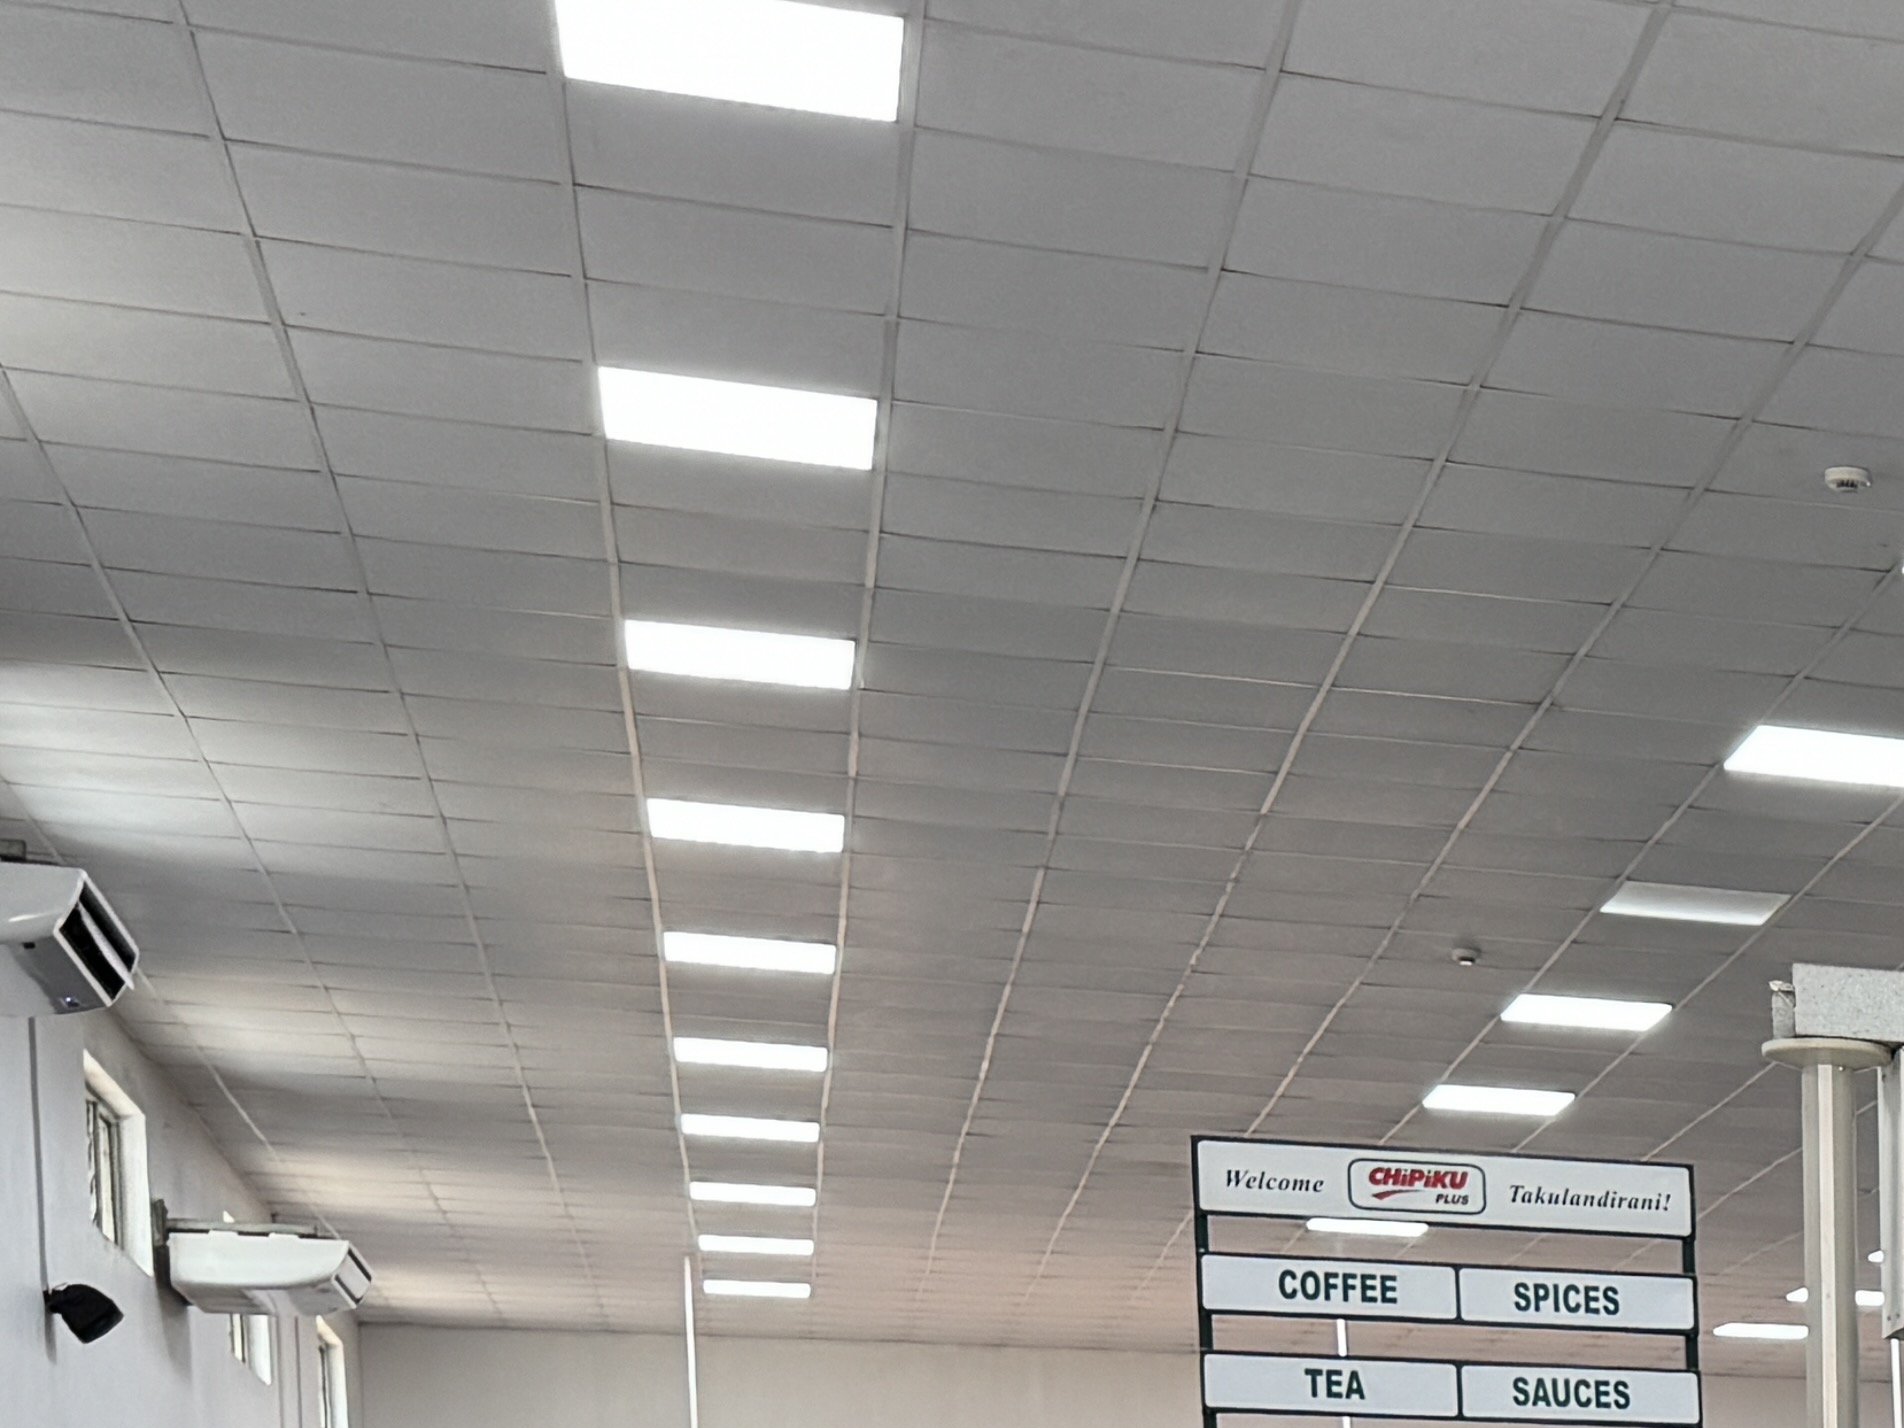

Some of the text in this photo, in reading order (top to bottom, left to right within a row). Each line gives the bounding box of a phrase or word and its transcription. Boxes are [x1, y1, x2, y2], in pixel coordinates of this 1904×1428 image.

[1225, 1168, 1325, 1194] Welcome
[1509, 1184, 1671, 1212] Takulandirani!
[1435, 1193, 1470, 1206] PLUS
[1279, 1268, 1398, 1305] COFFEE
[1513, 1282, 1620, 1316] SPICES
[1304, 1367, 1366, 1401] TEA
[1512, 1376, 1630, 1411] SAUCES
